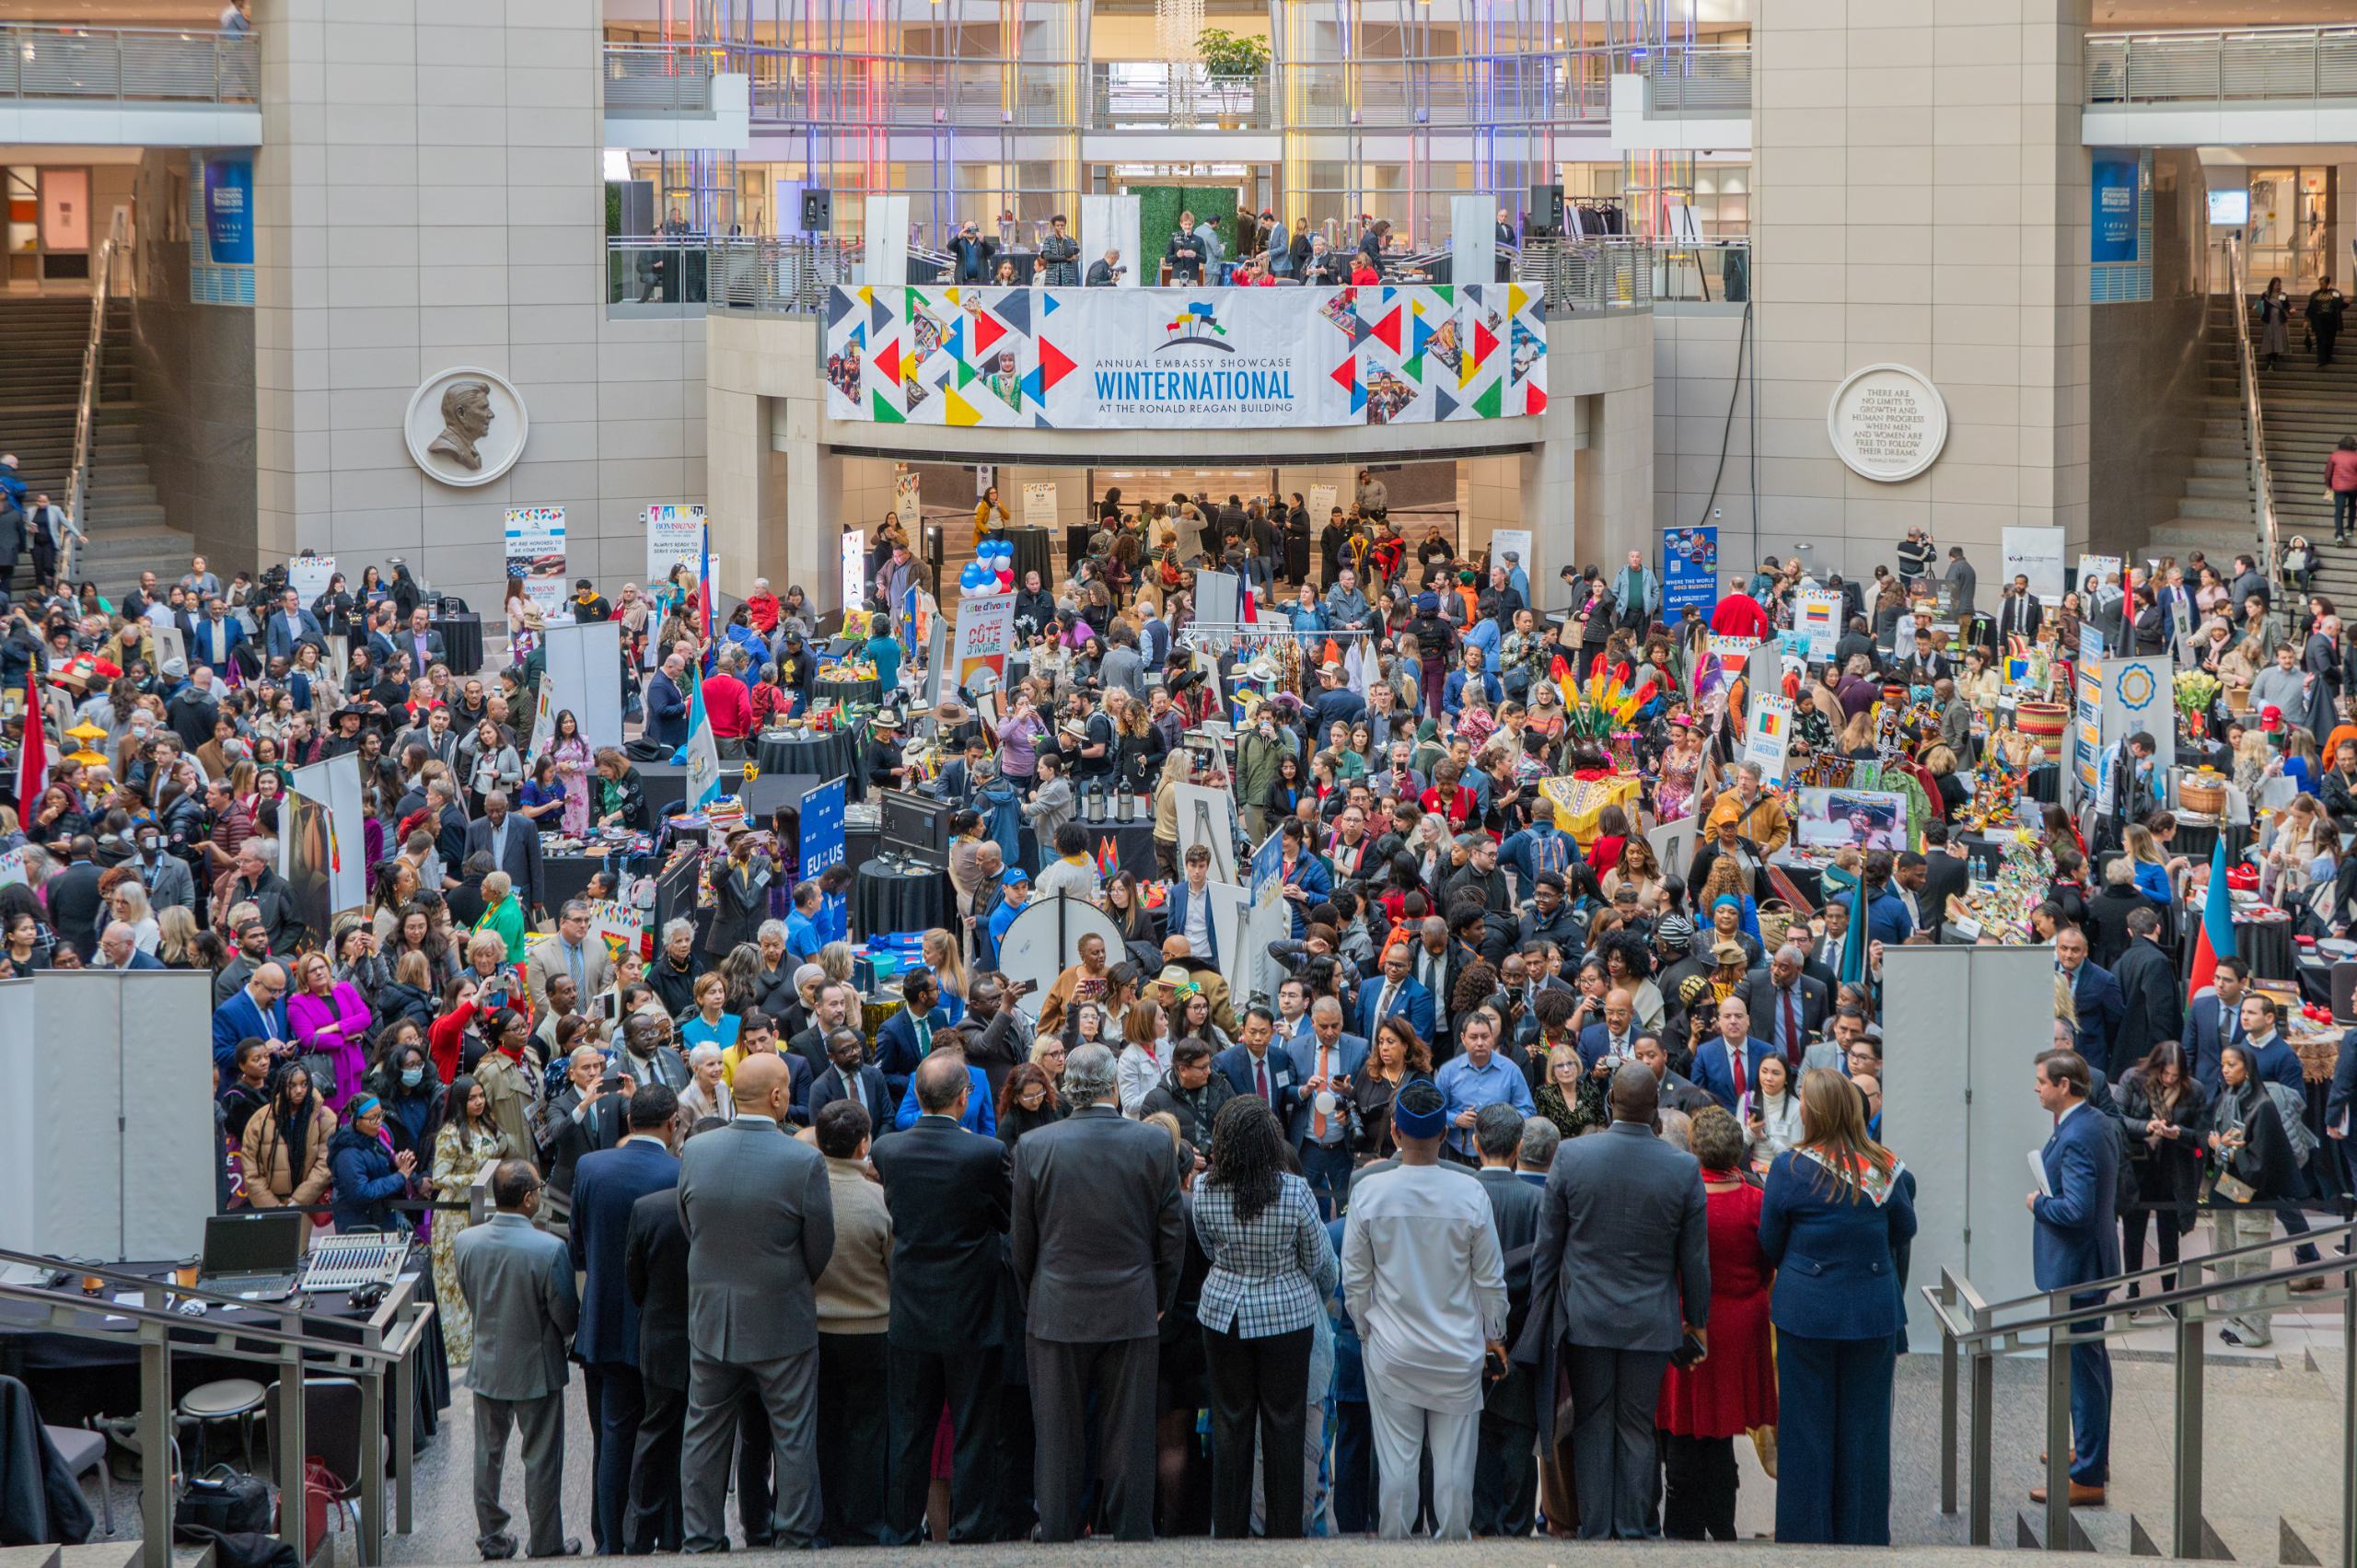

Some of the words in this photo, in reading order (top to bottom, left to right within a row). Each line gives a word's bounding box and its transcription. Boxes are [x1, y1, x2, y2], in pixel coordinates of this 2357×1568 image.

[1096, 359, 1149, 368] ANNUAL
[1155, 358, 1213, 368] EMBASSY
[1220, 357, 1292, 367] SHOWCASE
[1094, 370, 1295, 401] WINTERNATIONAL
[1867, 389, 1893, 397] THERE
[1862, 397, 1875, 405] NO
[1876, 398, 1902, 406] LIMITS
[1904, 398, 1916, 406] TO
[1098, 404, 1112, 413] AT
[1116, 404, 1135, 413] THE
[1139, 403, 1186, 413] RONALD
[1190, 403, 1237, 412] REAGAN
[1240, 402, 1293, 412] BUILDING
[1860, 405, 1897, 413] GROWTH
[1898, 406, 1917, 414] AND
[1852, 413, 1884, 422] HUMAN
[1886, 414, 1924, 423] PROGRESS
[1874, 431, 1906, 439] WOMEN
[1875, 439, 1887, 447] TO
[1888, 440, 1922, 448] FOLLOW
[969, 623, 1001, 645] CÔTE
[807, 853, 821, 877] EU
[829, 842, 843, 865] US
